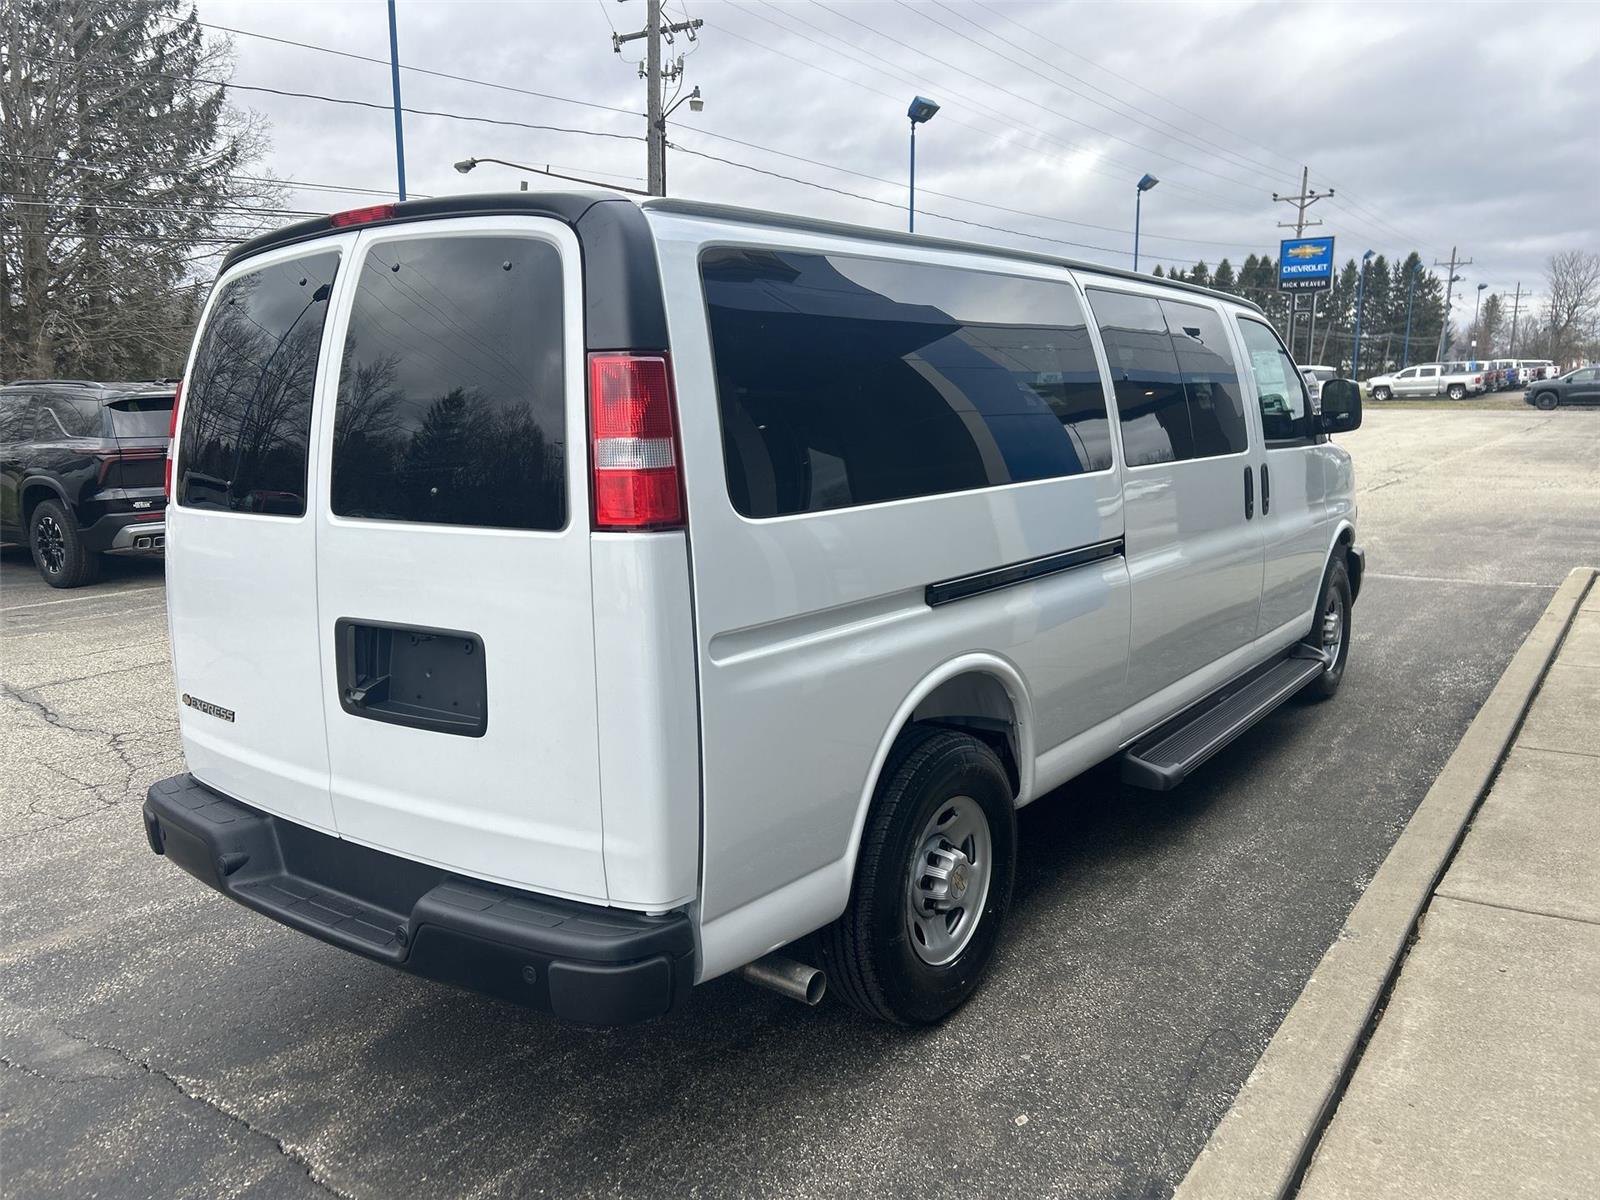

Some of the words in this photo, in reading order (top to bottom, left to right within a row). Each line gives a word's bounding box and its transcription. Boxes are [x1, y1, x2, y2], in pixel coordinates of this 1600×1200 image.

[1282, 264, 1328, 273] CHEVROLET
[1300, 280, 1326, 288] WEAVER
[191, 698, 234, 722] EXPRESS
